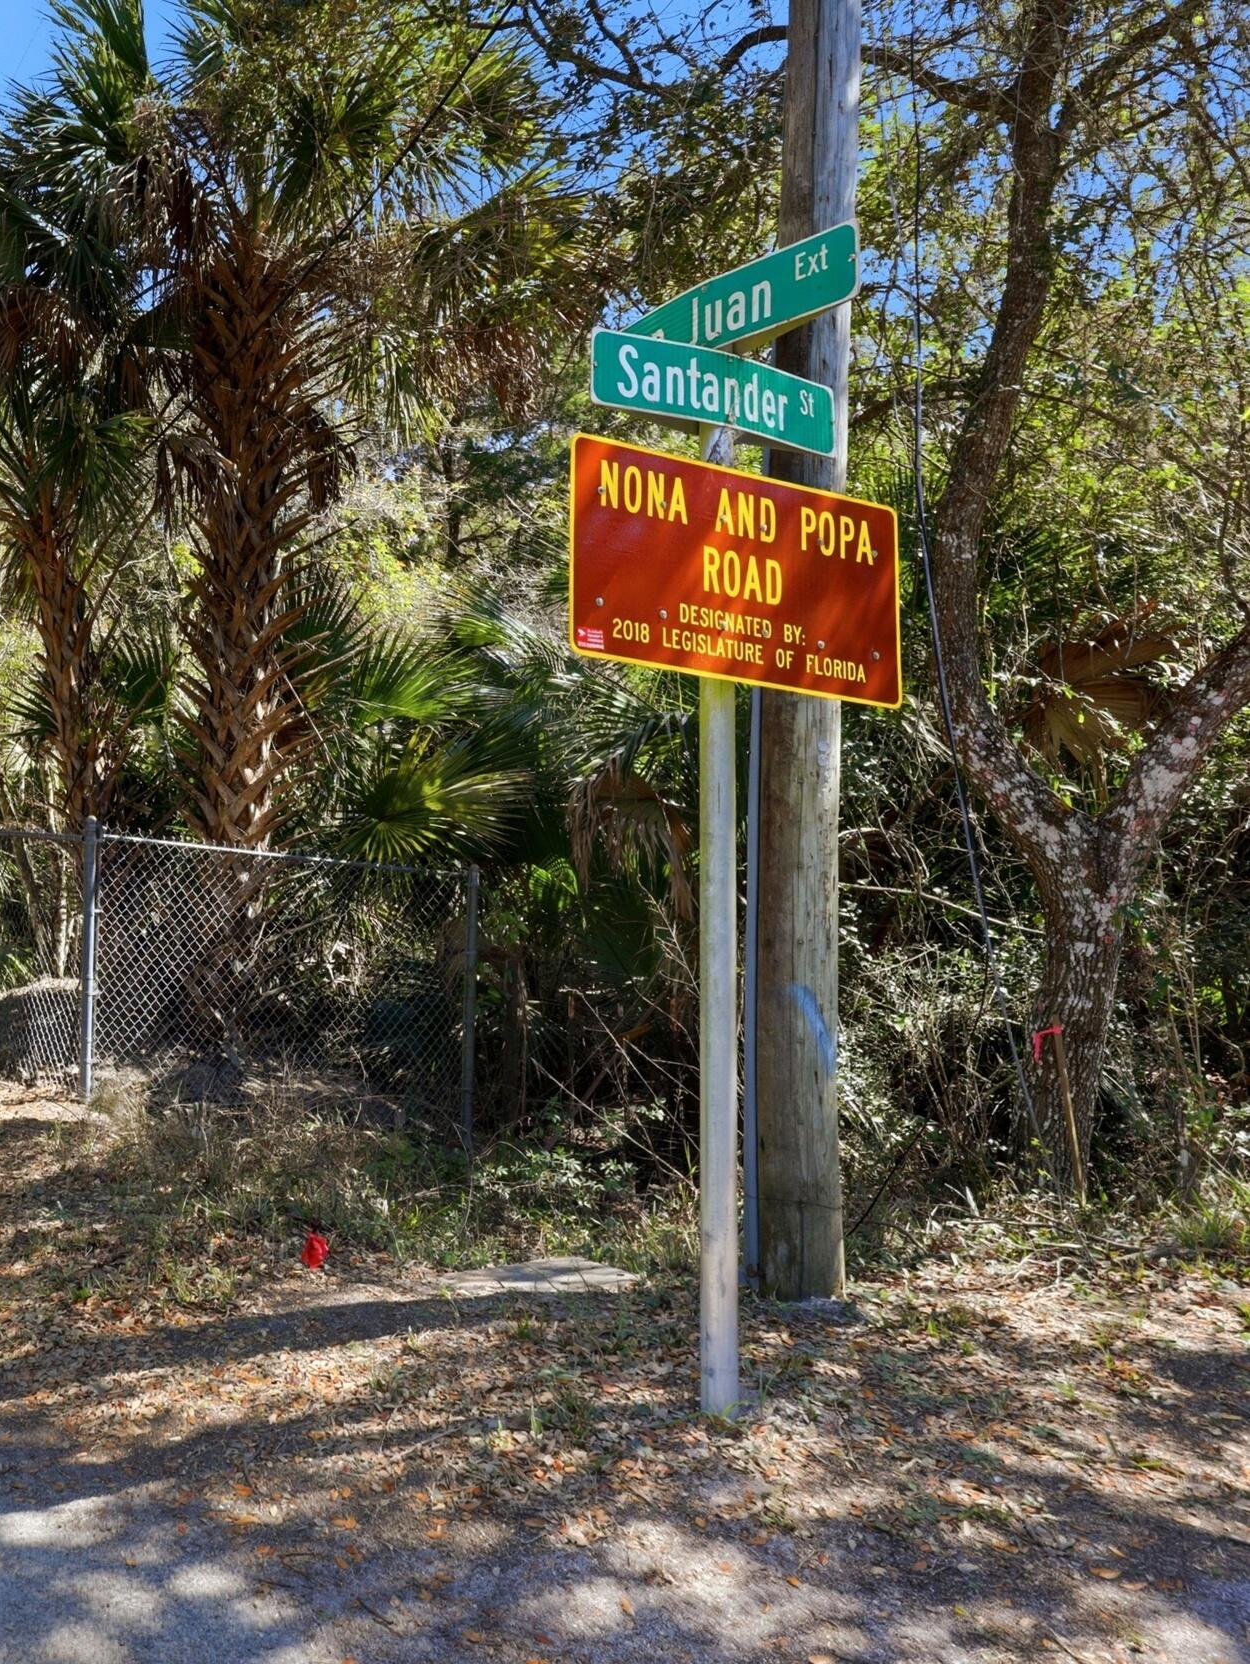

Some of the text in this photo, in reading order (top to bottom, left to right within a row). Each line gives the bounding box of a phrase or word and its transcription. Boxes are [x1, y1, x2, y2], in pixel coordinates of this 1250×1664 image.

[691, 243, 829, 346] Juan Ext
[617, 344, 815, 431] Santander St
[600, 459, 874, 566] NONA AND POPA
[703, 545, 782, 606] ROAD
[612, 618, 650, 644] 2018
[662, 627, 764, 665] LEGISLATURE
[776, 649, 795, 669] OF
[806, 654, 866, 684] FLORIDA
[679, 603, 806, 646] DESIGNATED BY:
